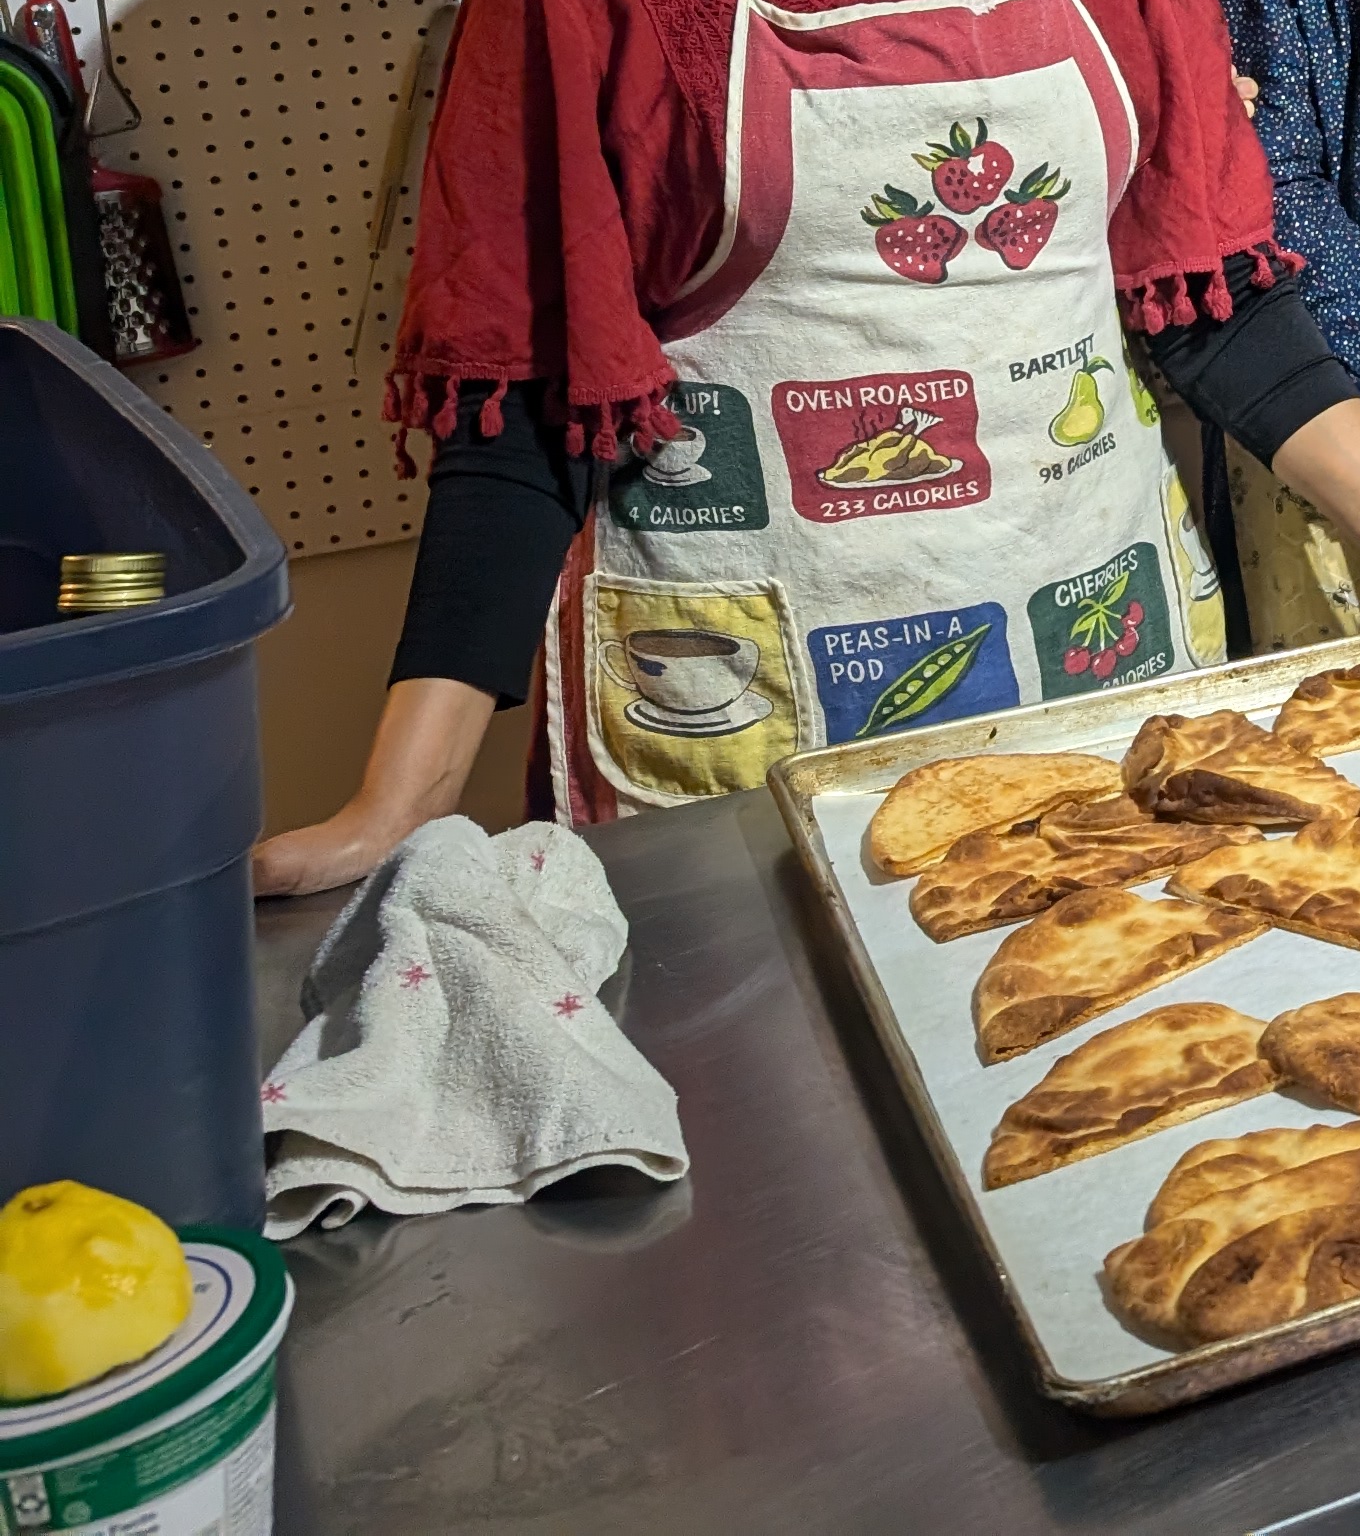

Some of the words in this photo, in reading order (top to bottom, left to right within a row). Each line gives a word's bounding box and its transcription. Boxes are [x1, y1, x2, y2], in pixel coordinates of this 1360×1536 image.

[1008, 333, 1096, 383] BARTLETT
[685, 390, 721, 416] UP!
[785, 387, 854, 416] OVEN
[859, 377, 969, 410] ROASTED
[1039, 460, 1063, 485] 98
[1065, 431, 1117, 476] CALORIES
[629, 506, 640, 522] 4
[649, 505, 746, 526] CALORIES
[820, 497, 866, 520] 233
[873, 480, 980, 512] CALORIES
[1054, 549, 1138, 606] CHERRIES
[824, 617, 965, 657] PEAS-IN-A
[830, 658, 884, 685] POD
